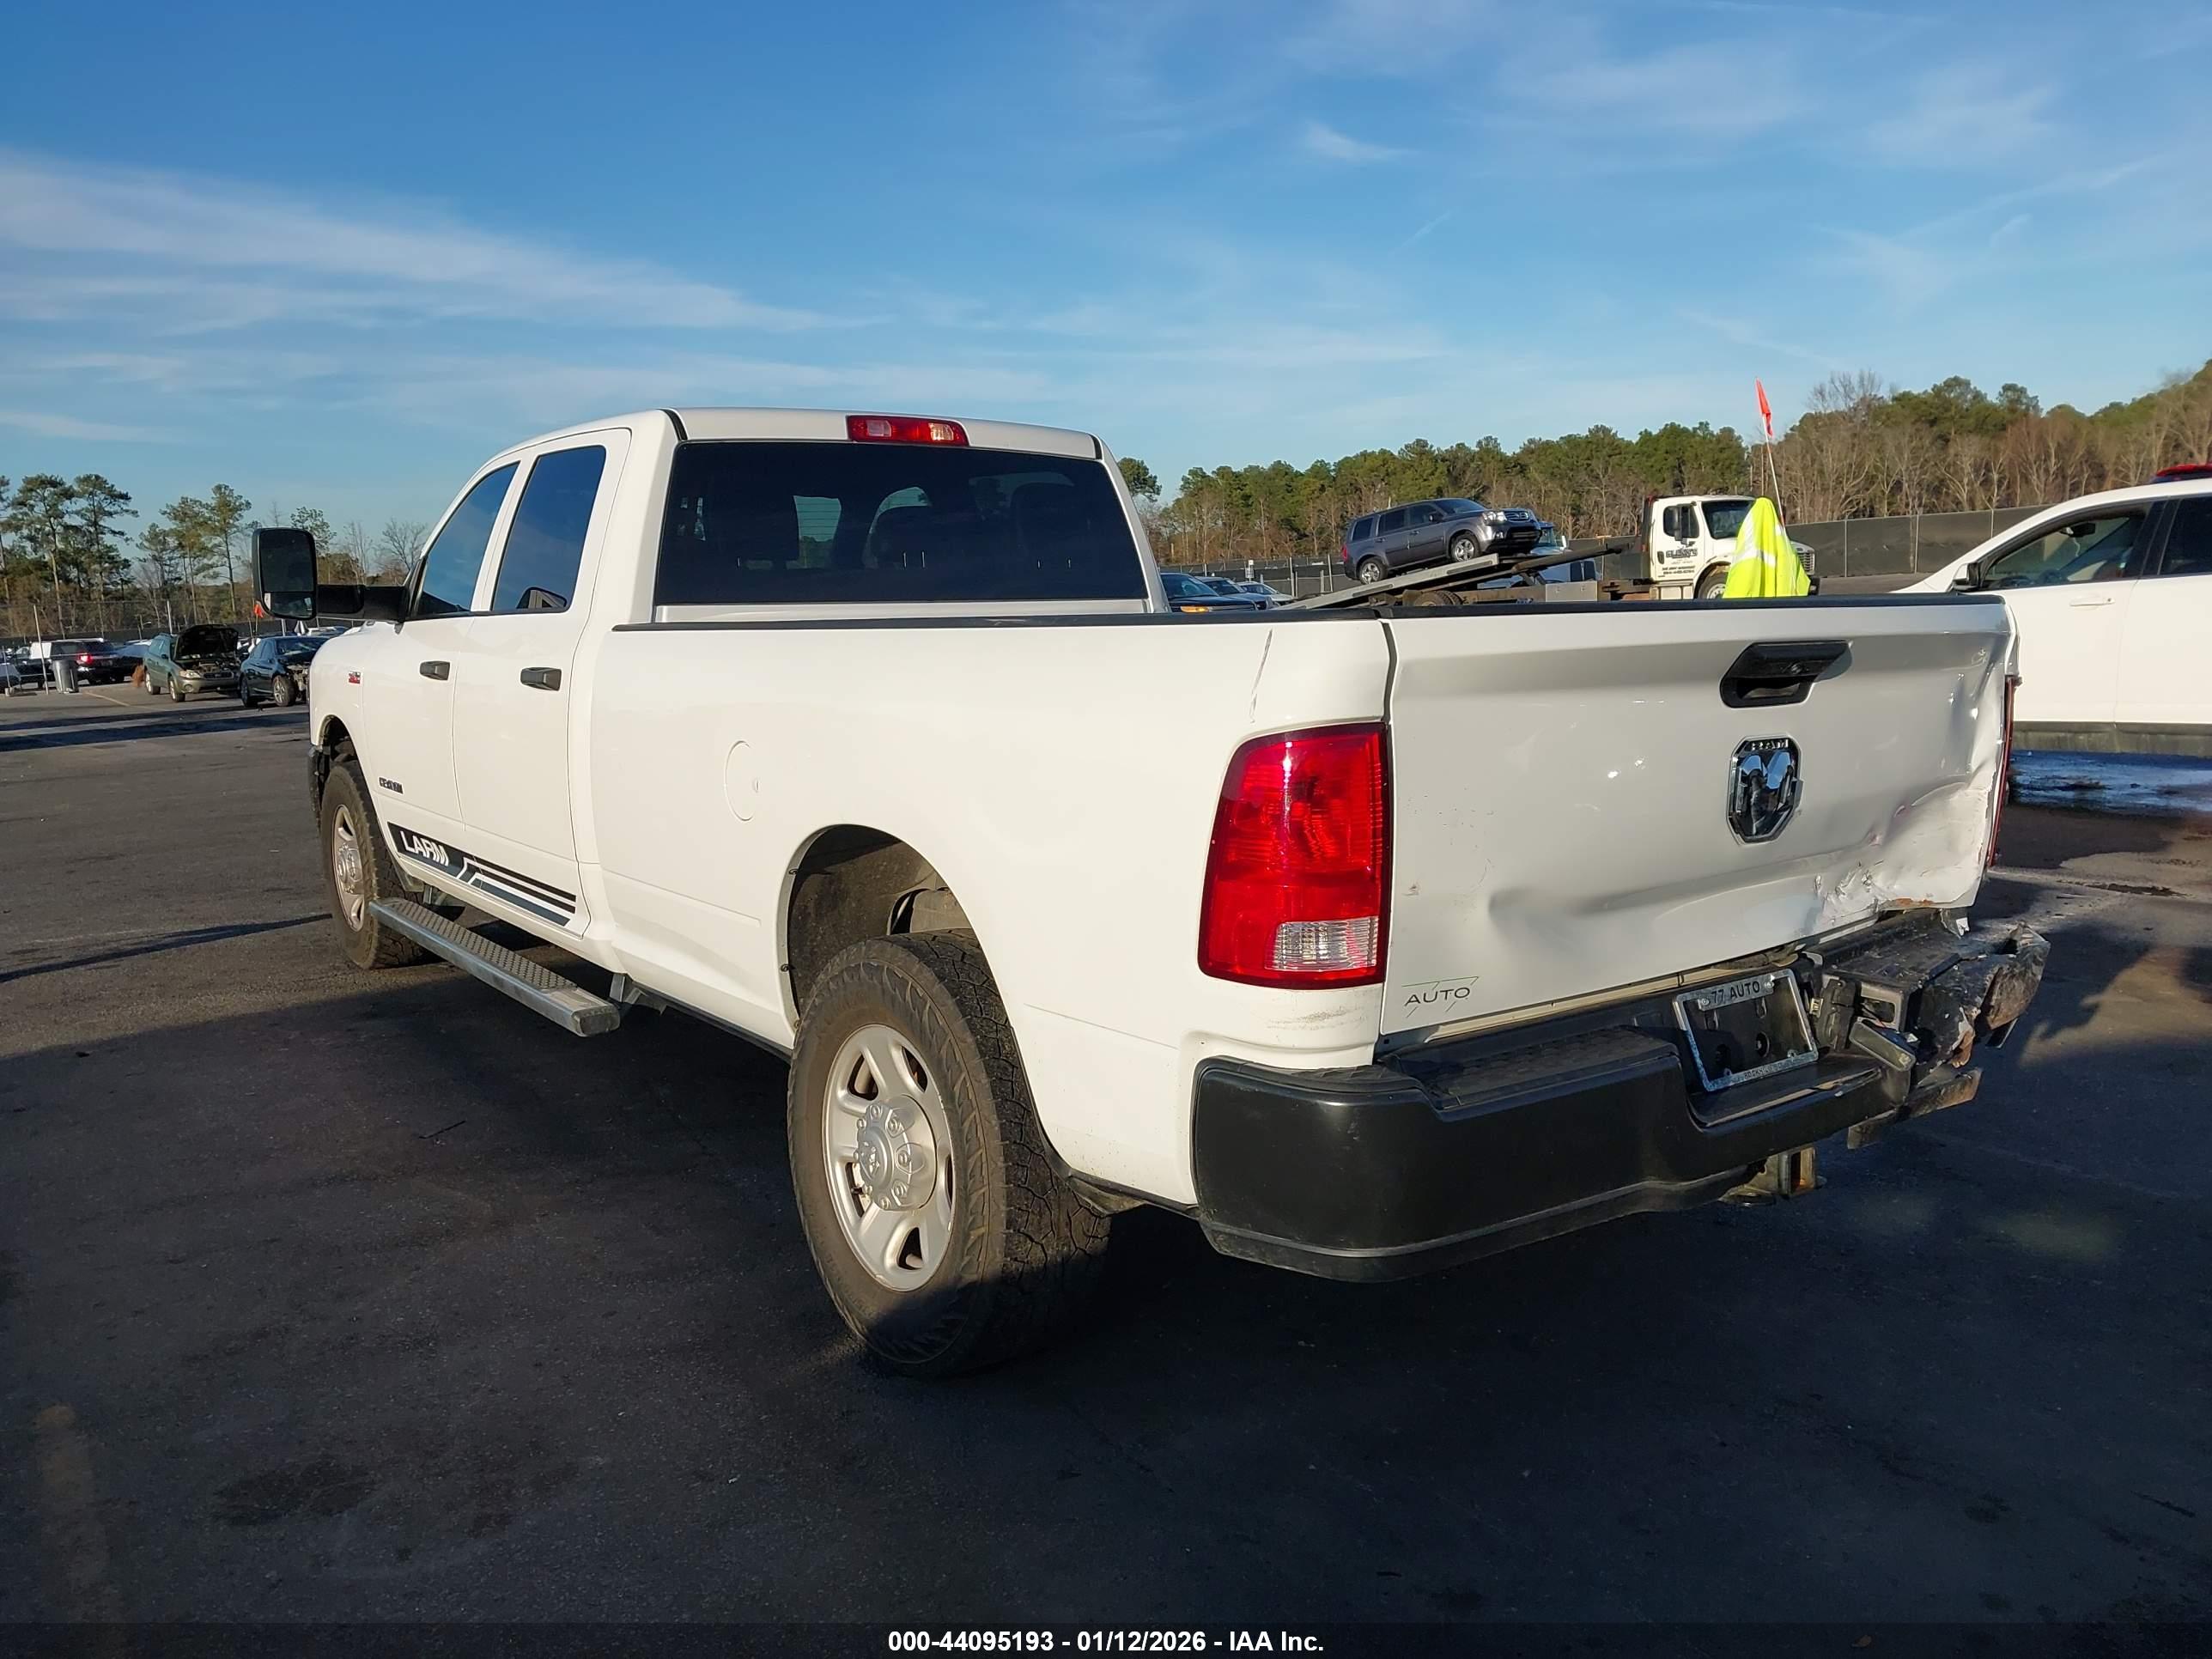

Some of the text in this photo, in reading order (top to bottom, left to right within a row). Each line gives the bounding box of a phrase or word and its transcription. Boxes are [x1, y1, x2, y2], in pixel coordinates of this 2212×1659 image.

[1404, 987, 1470, 1006] AUTO
[1711, 981, 1760, 1004] 77 AUTO
